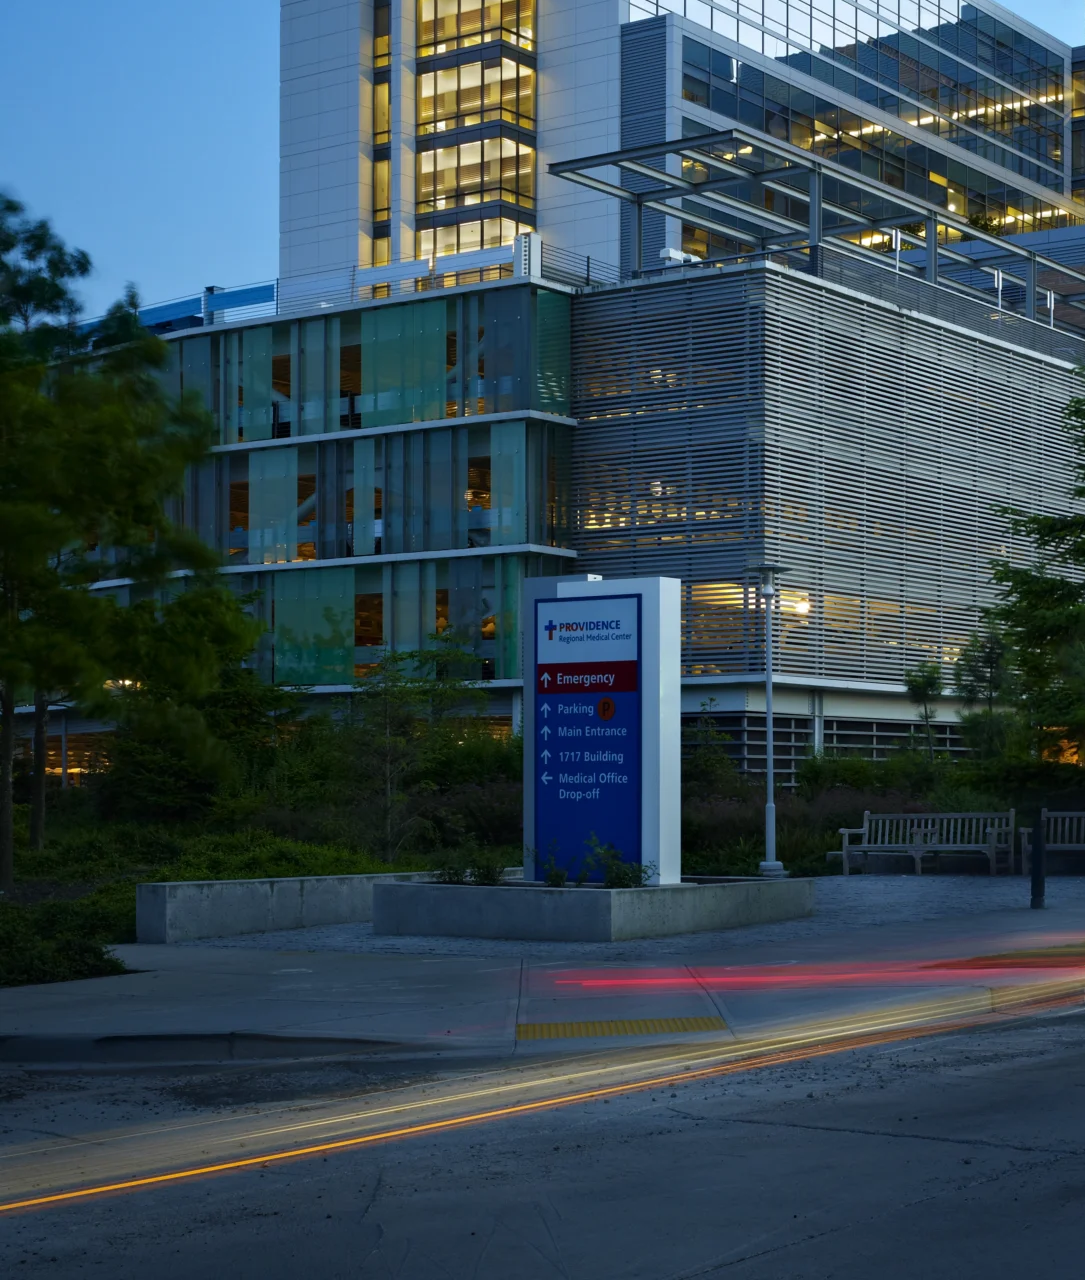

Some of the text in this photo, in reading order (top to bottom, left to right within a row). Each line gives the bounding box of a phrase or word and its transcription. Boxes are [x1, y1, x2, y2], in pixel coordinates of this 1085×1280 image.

[559, 619, 621, 632] PROVIDENCE
[559, 632, 632, 644] Regional Medical Center
[557, 673, 615, 687] Emergency
[558, 702, 611, 717] Parking P
[558, 725, 627, 737] Main Entrance
[559, 751, 624, 764] 1717 Building
[559, 772, 628, 784] Medical Office
[559, 788, 600, 802] Drop-off
